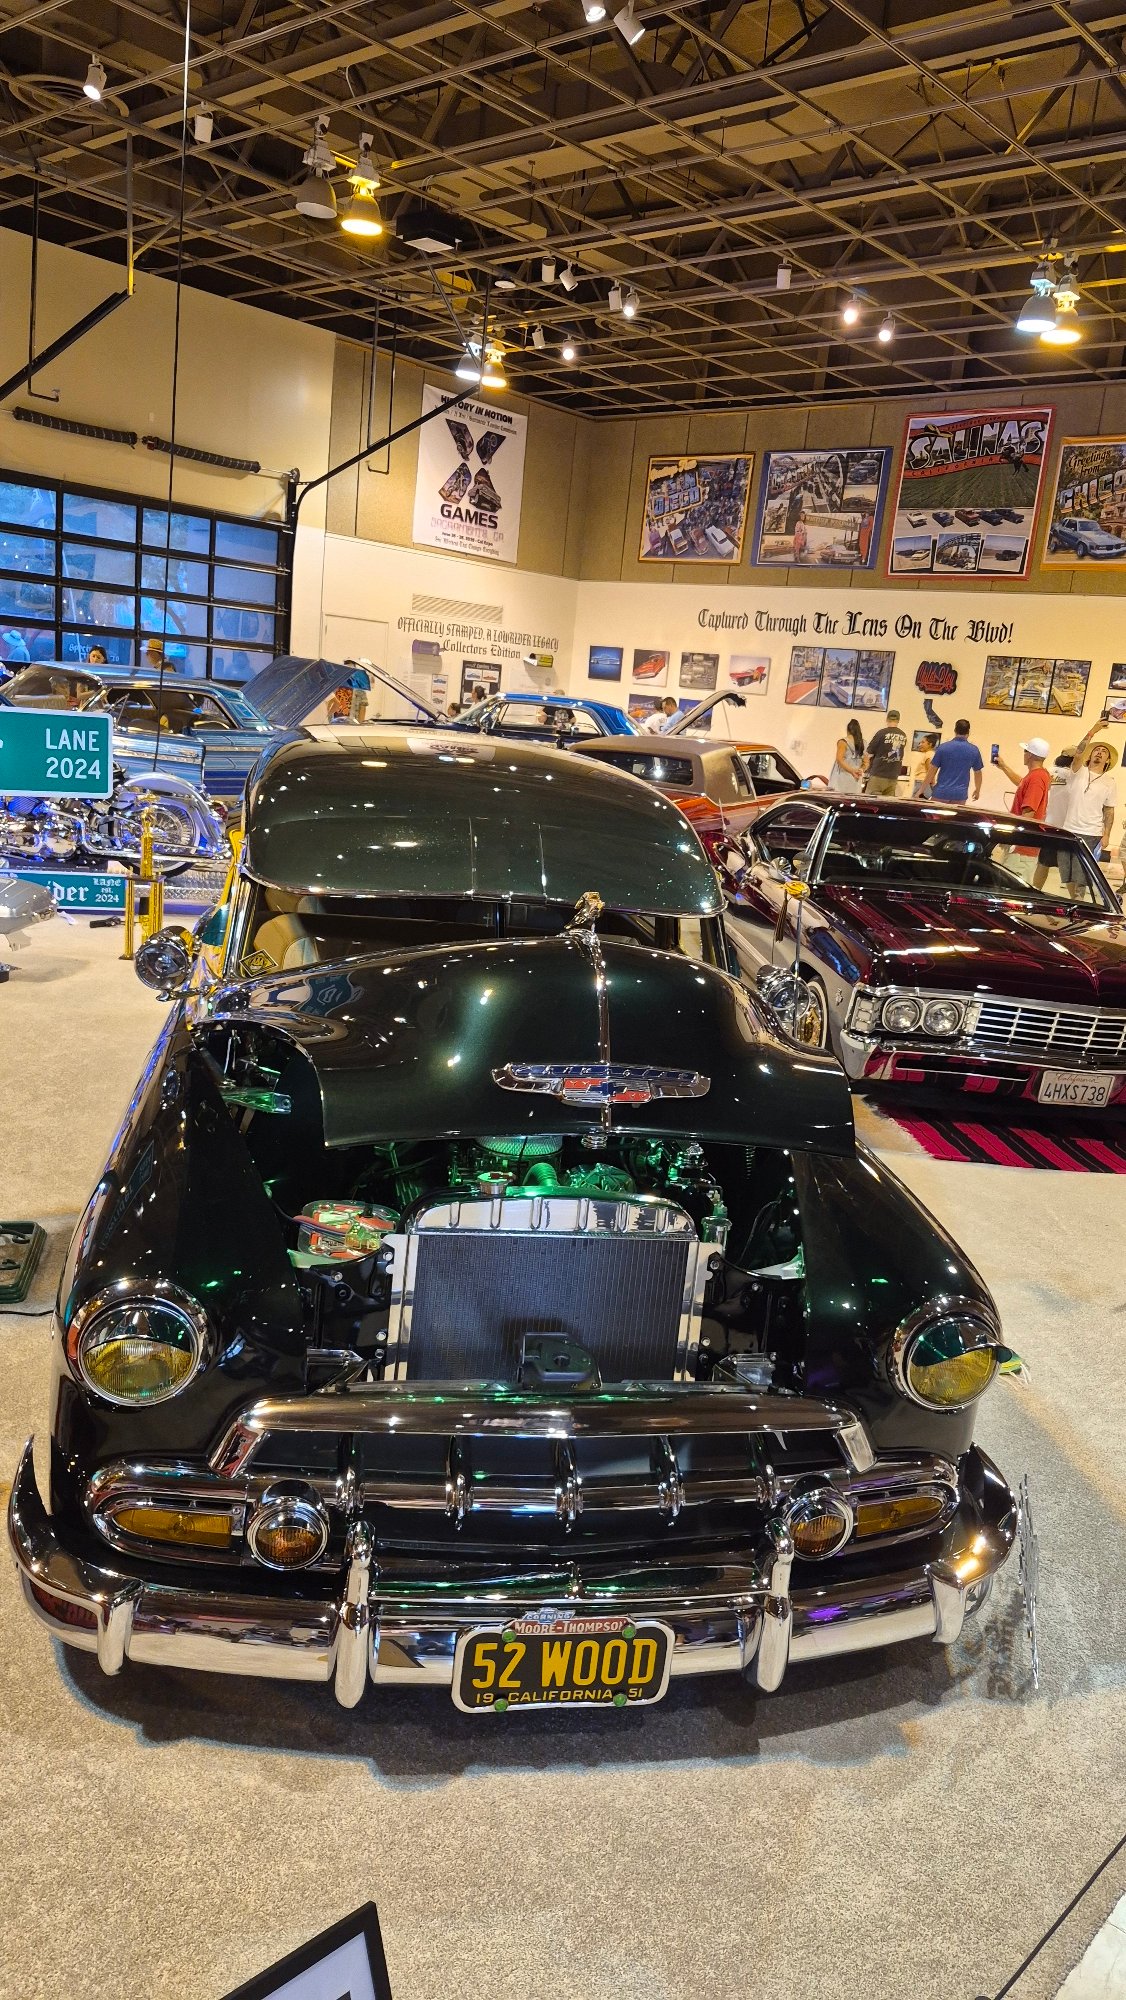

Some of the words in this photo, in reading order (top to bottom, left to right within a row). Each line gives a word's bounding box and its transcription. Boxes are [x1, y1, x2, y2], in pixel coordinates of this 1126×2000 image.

[475, 406, 484, 415] IN
[485, 409, 513, 424] MOTION
[910, 420, 1043, 470] SALINAS
[654, 486, 700, 516] DIEGO
[440, 503, 499, 529] GAMES
[397, 616, 445, 637] OFFICIALLY
[486, 628, 492, 641] A
[493, 629, 532, 646] LOWRIDER
[532, 635, 559, 653] LEGACY
[697, 608, 749, 631] Captured
[755, 610, 807, 637] Through
[813, 612, 839, 635] The
[842, 610, 888, 637] Lens
[895, 614, 922, 639] On
[929, 617, 959, 641] The
[965, 619, 1014, 644] Blvd!
[443, 638, 487, 656] Collectors
[490, 644, 521, 659] Edition
[45, 727, 100, 752] LANE
[45, 756, 101, 780] 2024
[93, 877, 122, 886] LANE
[95, 893, 120, 903] 2024
[1043, 1083, 1106, 1102] 4HXS738
[514, 1619, 627, 1635] MOORE-THOMPSON
[471, 1642, 527, 1689] 52
[541, 1638, 658, 1688] WOOD
[475, 1692, 494, 1704] 19
[508, 1688, 613, 1703] CALIFORNIA
[627, 1687, 643, 1699] 51
